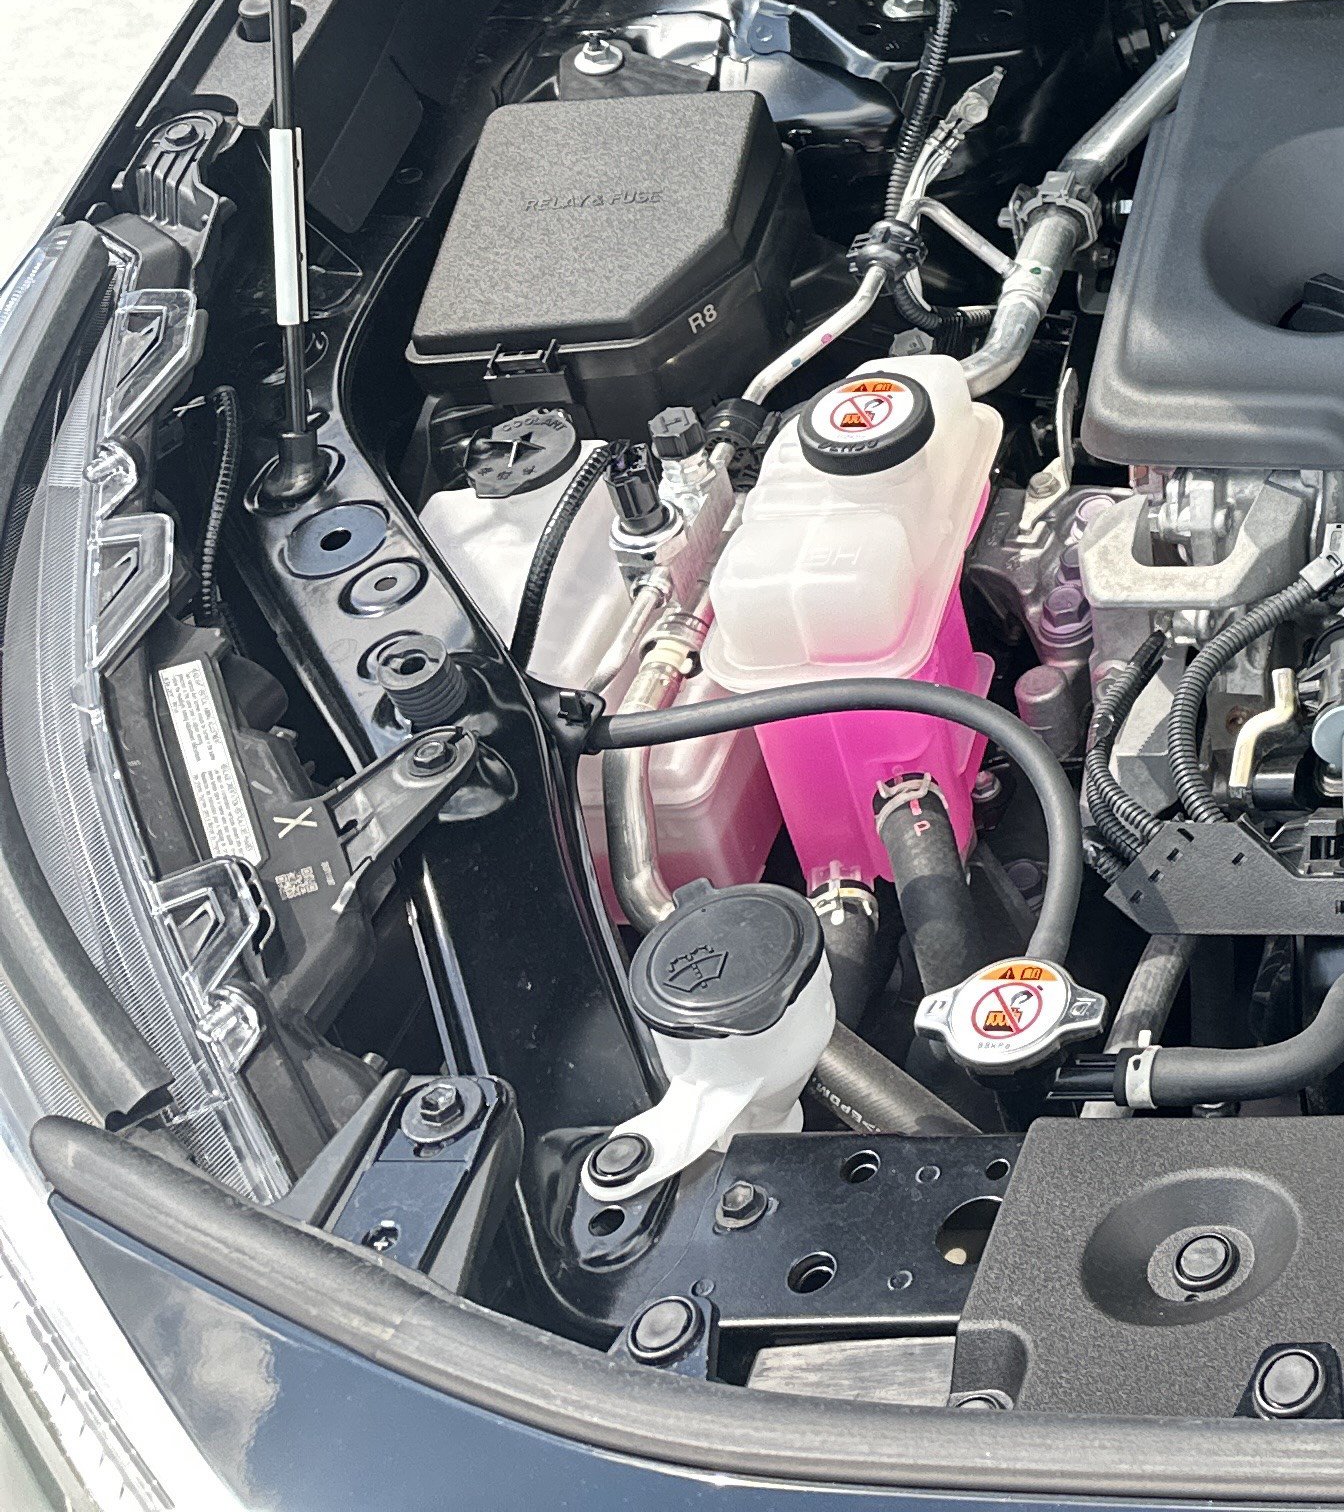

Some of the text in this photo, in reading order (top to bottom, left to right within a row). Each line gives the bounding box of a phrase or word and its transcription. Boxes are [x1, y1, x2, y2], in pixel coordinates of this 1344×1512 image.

[525, 194, 591, 212] RELAY
[608, 189, 662, 206] FUSE
[687, 303, 718, 334] R8
[913, 819, 931, 837] P
